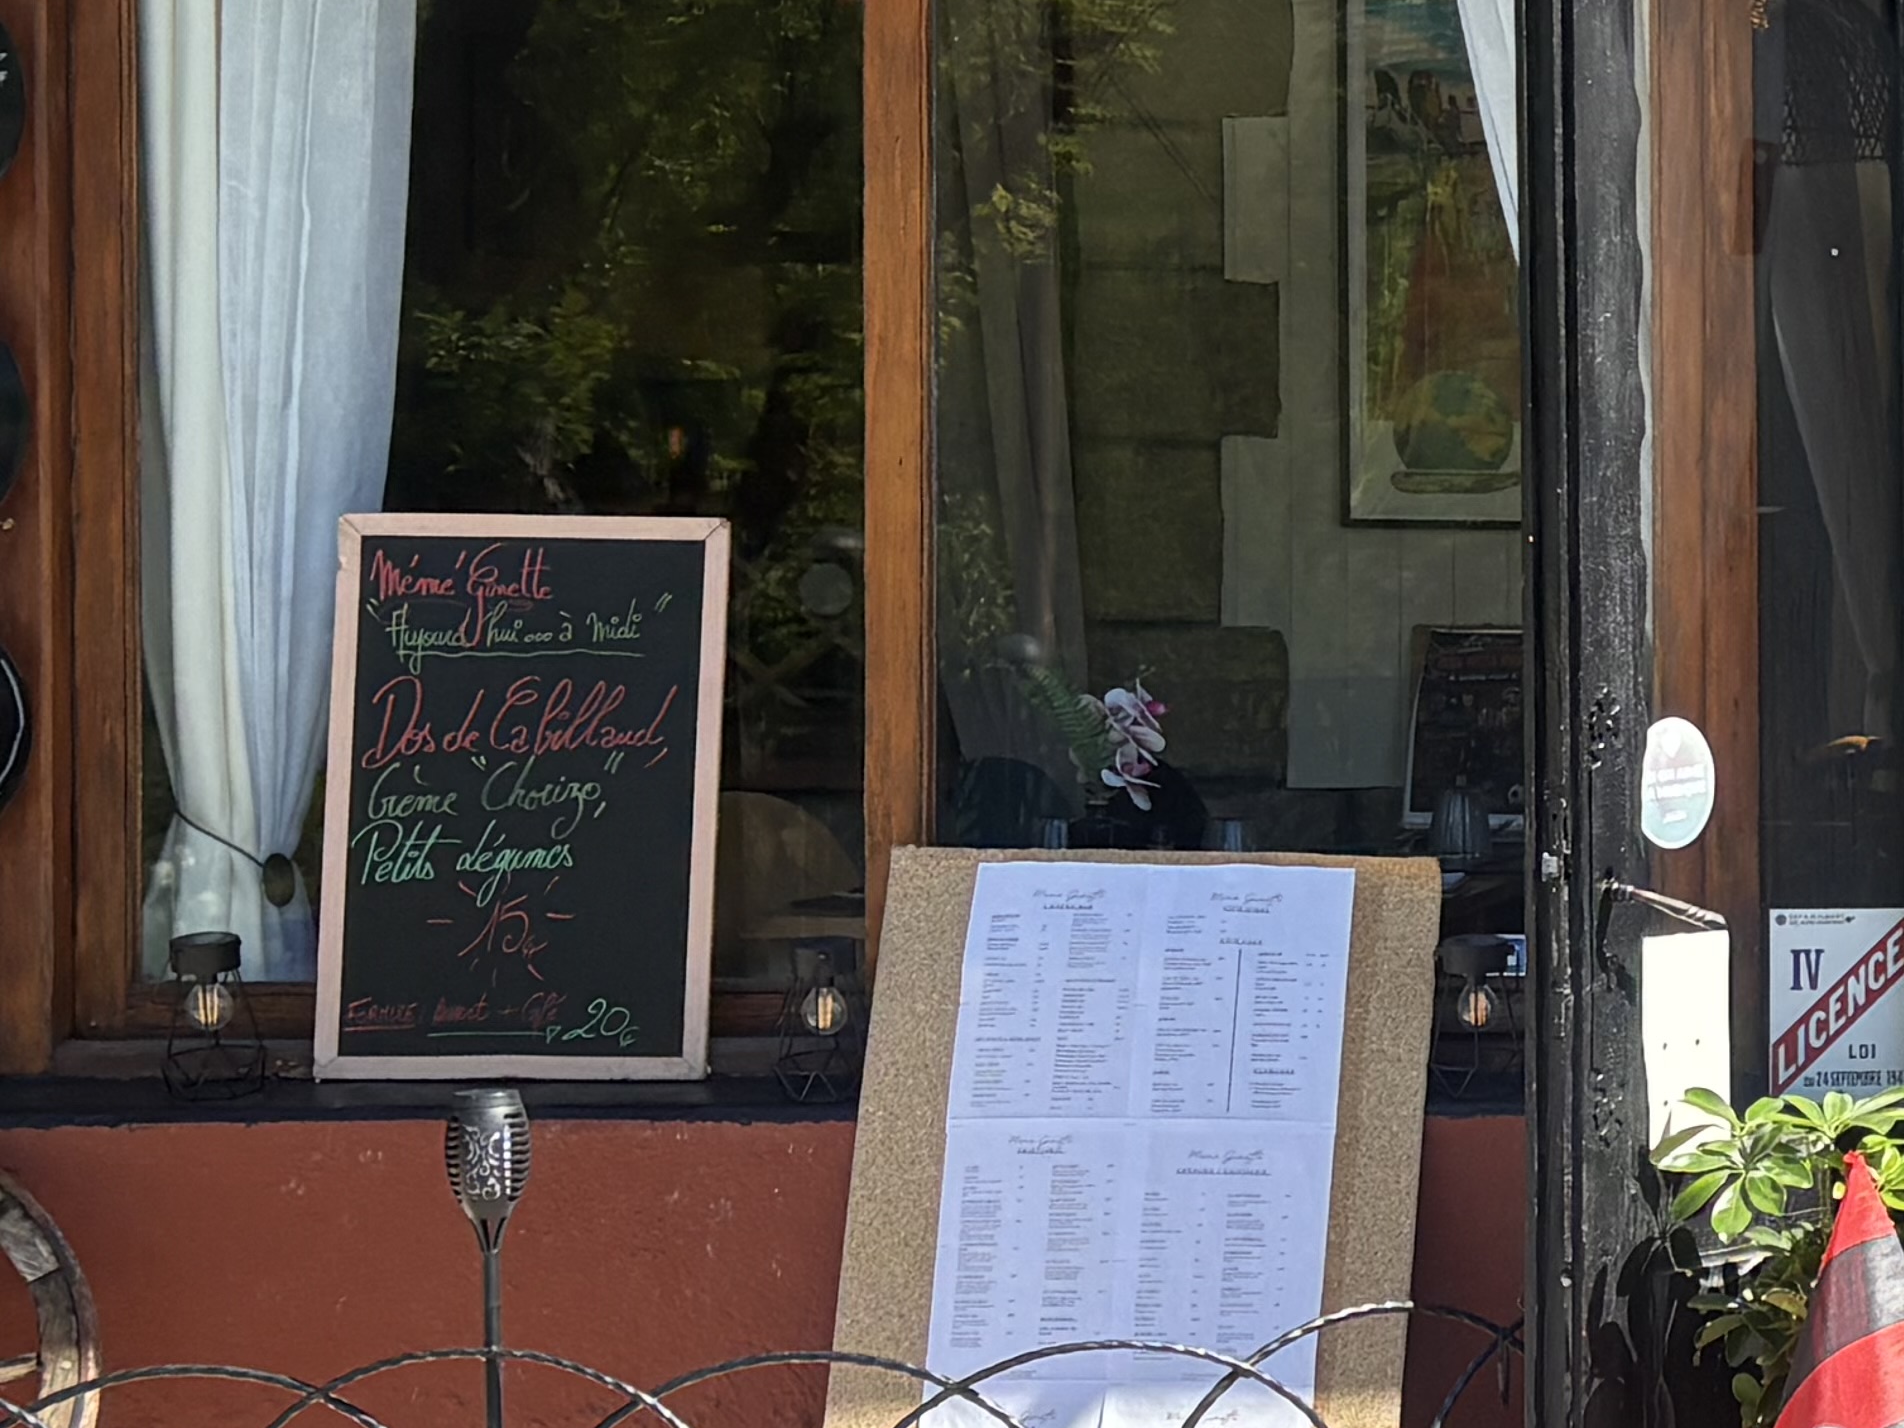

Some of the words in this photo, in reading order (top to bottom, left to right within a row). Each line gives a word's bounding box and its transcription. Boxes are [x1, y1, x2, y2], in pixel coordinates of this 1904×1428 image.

[369, 549, 457, 602] Mémé
[468, 543, 556, 642] Ginette
[362, 675, 434, 769] Dos
[442, 689, 486, 753] de
[351, 819, 462, 886] Petits
[1790, 949, 1825, 991] IV
[1848, 1043, 1877, 1060] LOI
